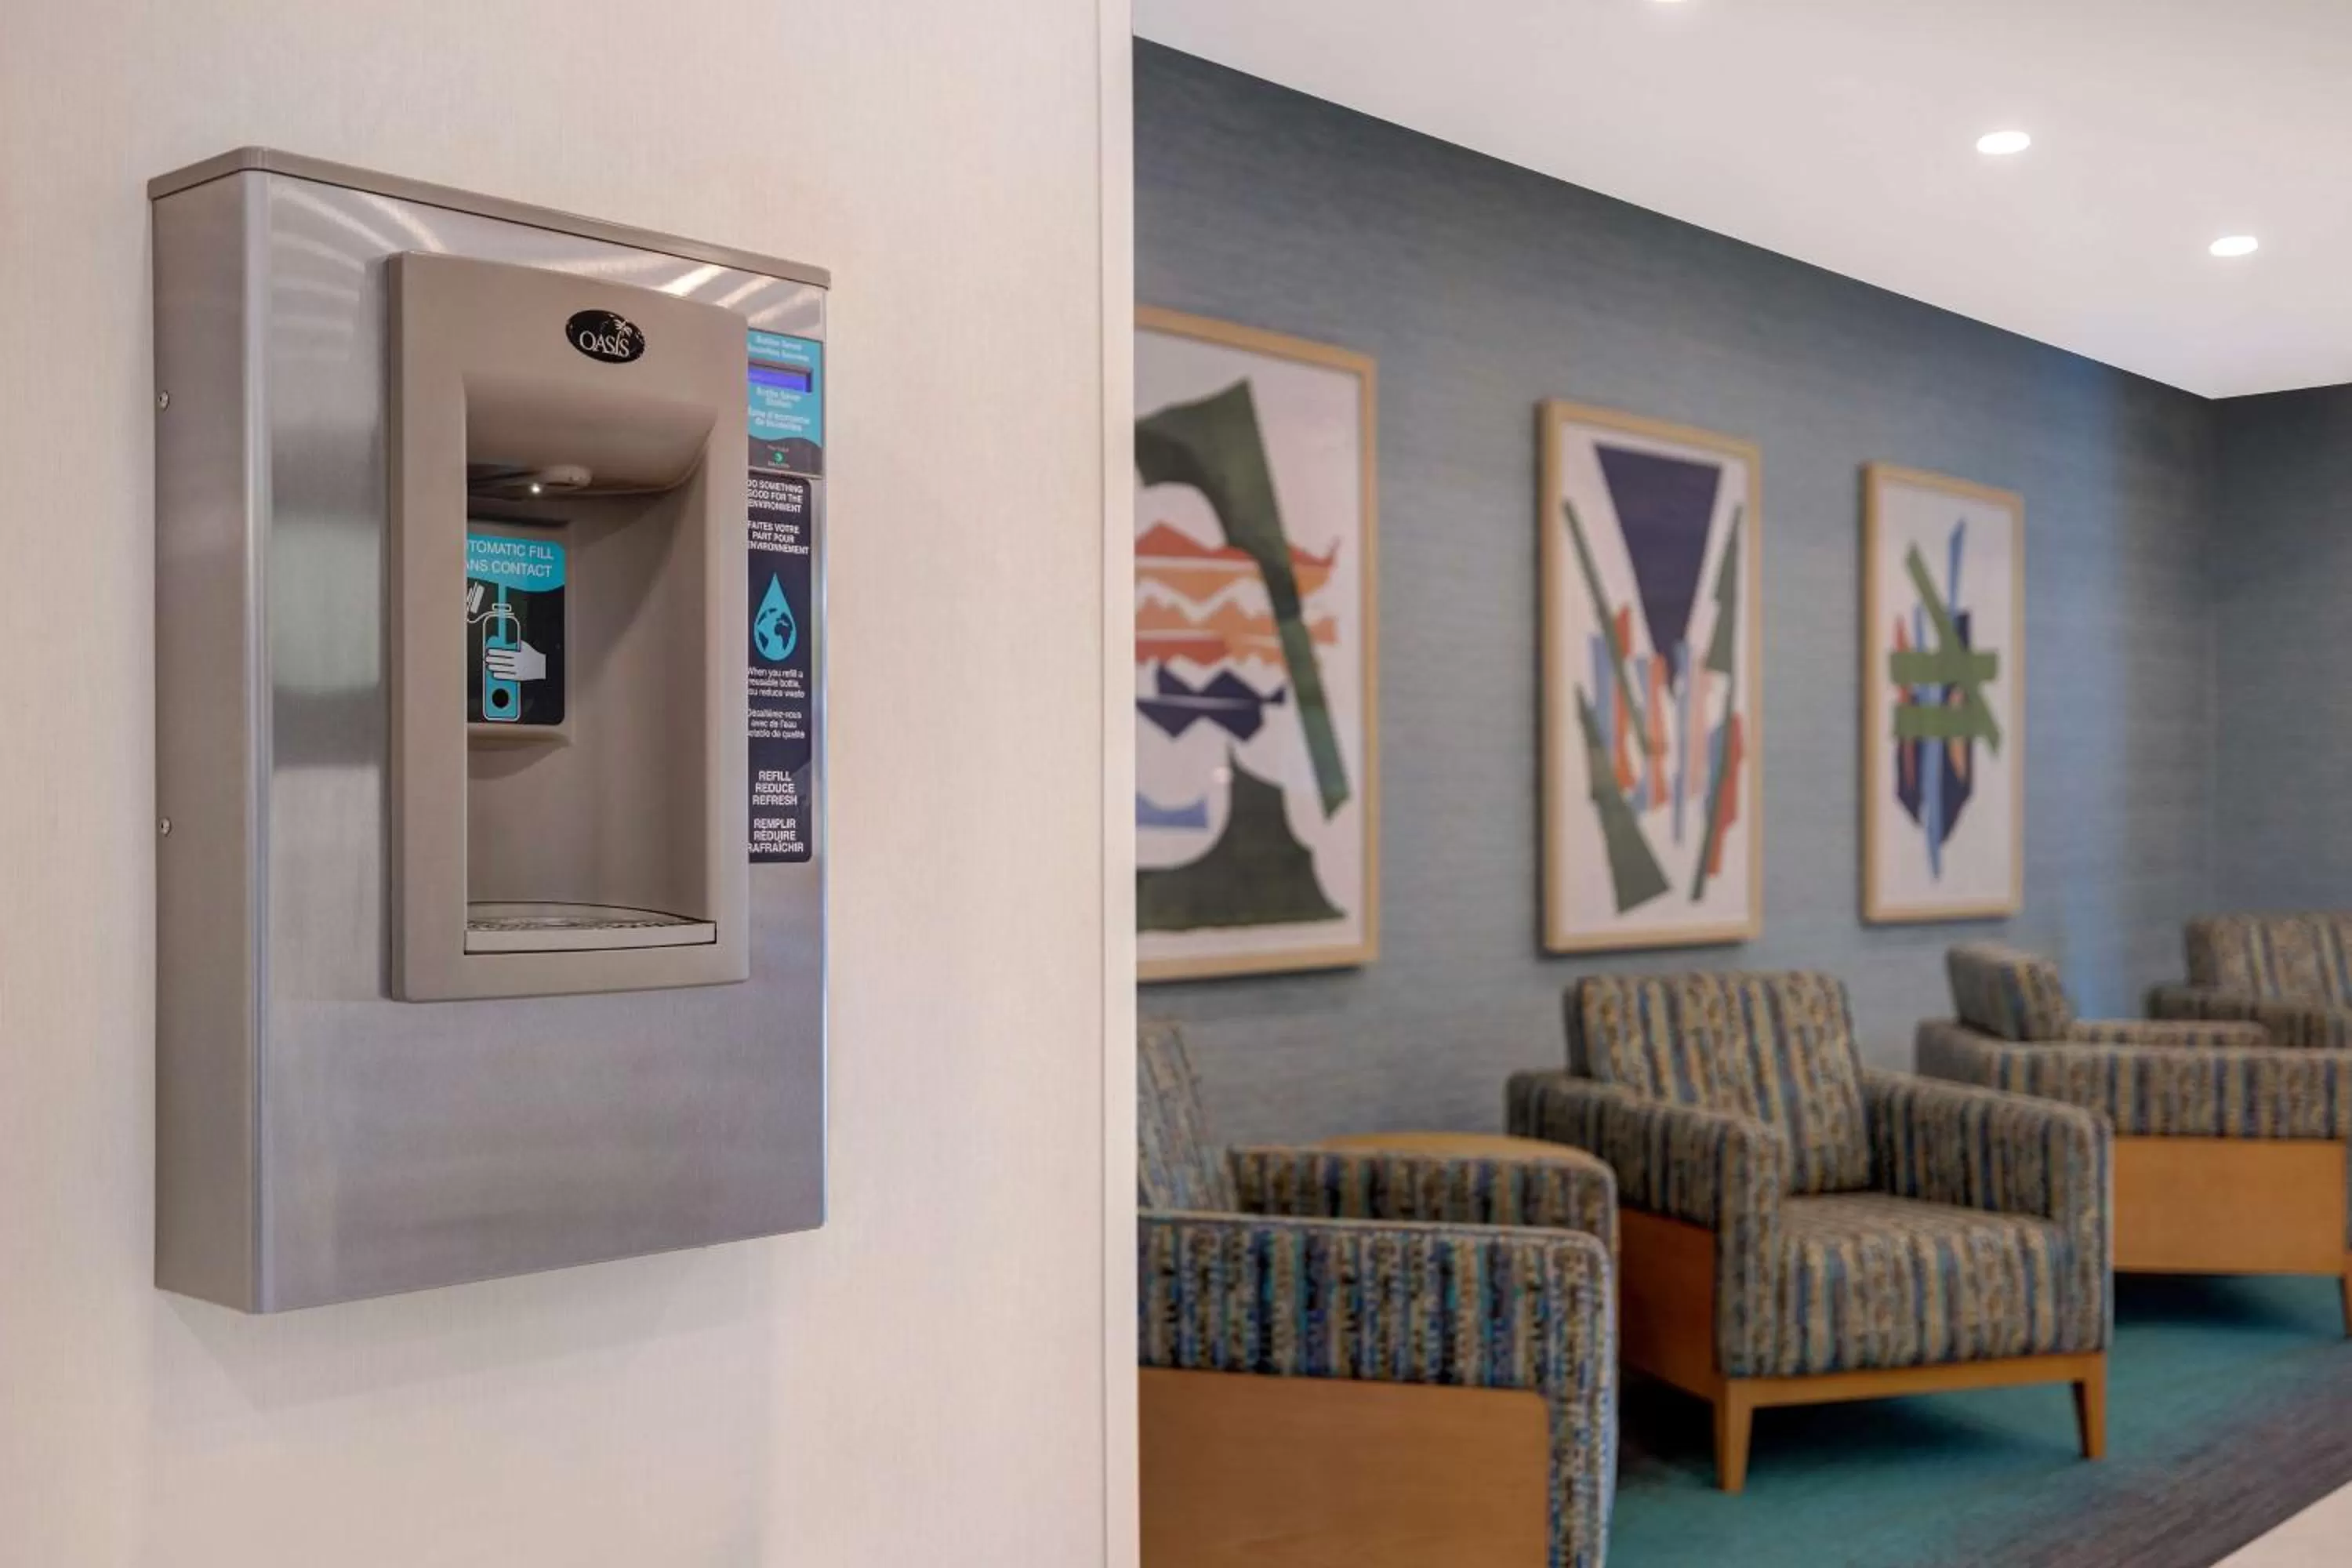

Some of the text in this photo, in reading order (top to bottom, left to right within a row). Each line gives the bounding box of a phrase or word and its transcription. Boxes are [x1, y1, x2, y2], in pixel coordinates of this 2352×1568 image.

[580, 330, 630, 358] OASIS
[758, 481, 804, 494] SOMETHING
[771, 492, 786, 501] FOR
[787, 493, 803, 504] THE
[774, 523, 800, 534] VOTRE
[753, 532, 795, 543] PART POUR
[466, 539, 554, 560] TOMATIC FILL
[492, 561, 553, 578] CONTACT
[768, 670, 782, 679] you
[750, 720, 768, 728] avec
[771, 729, 782, 738] de
[758, 771, 793, 782] REFILL
[755, 782, 796, 794] REDUCE
[753, 794, 798, 806] REFRESH
[753, 818, 797, 829] REMPLIR
